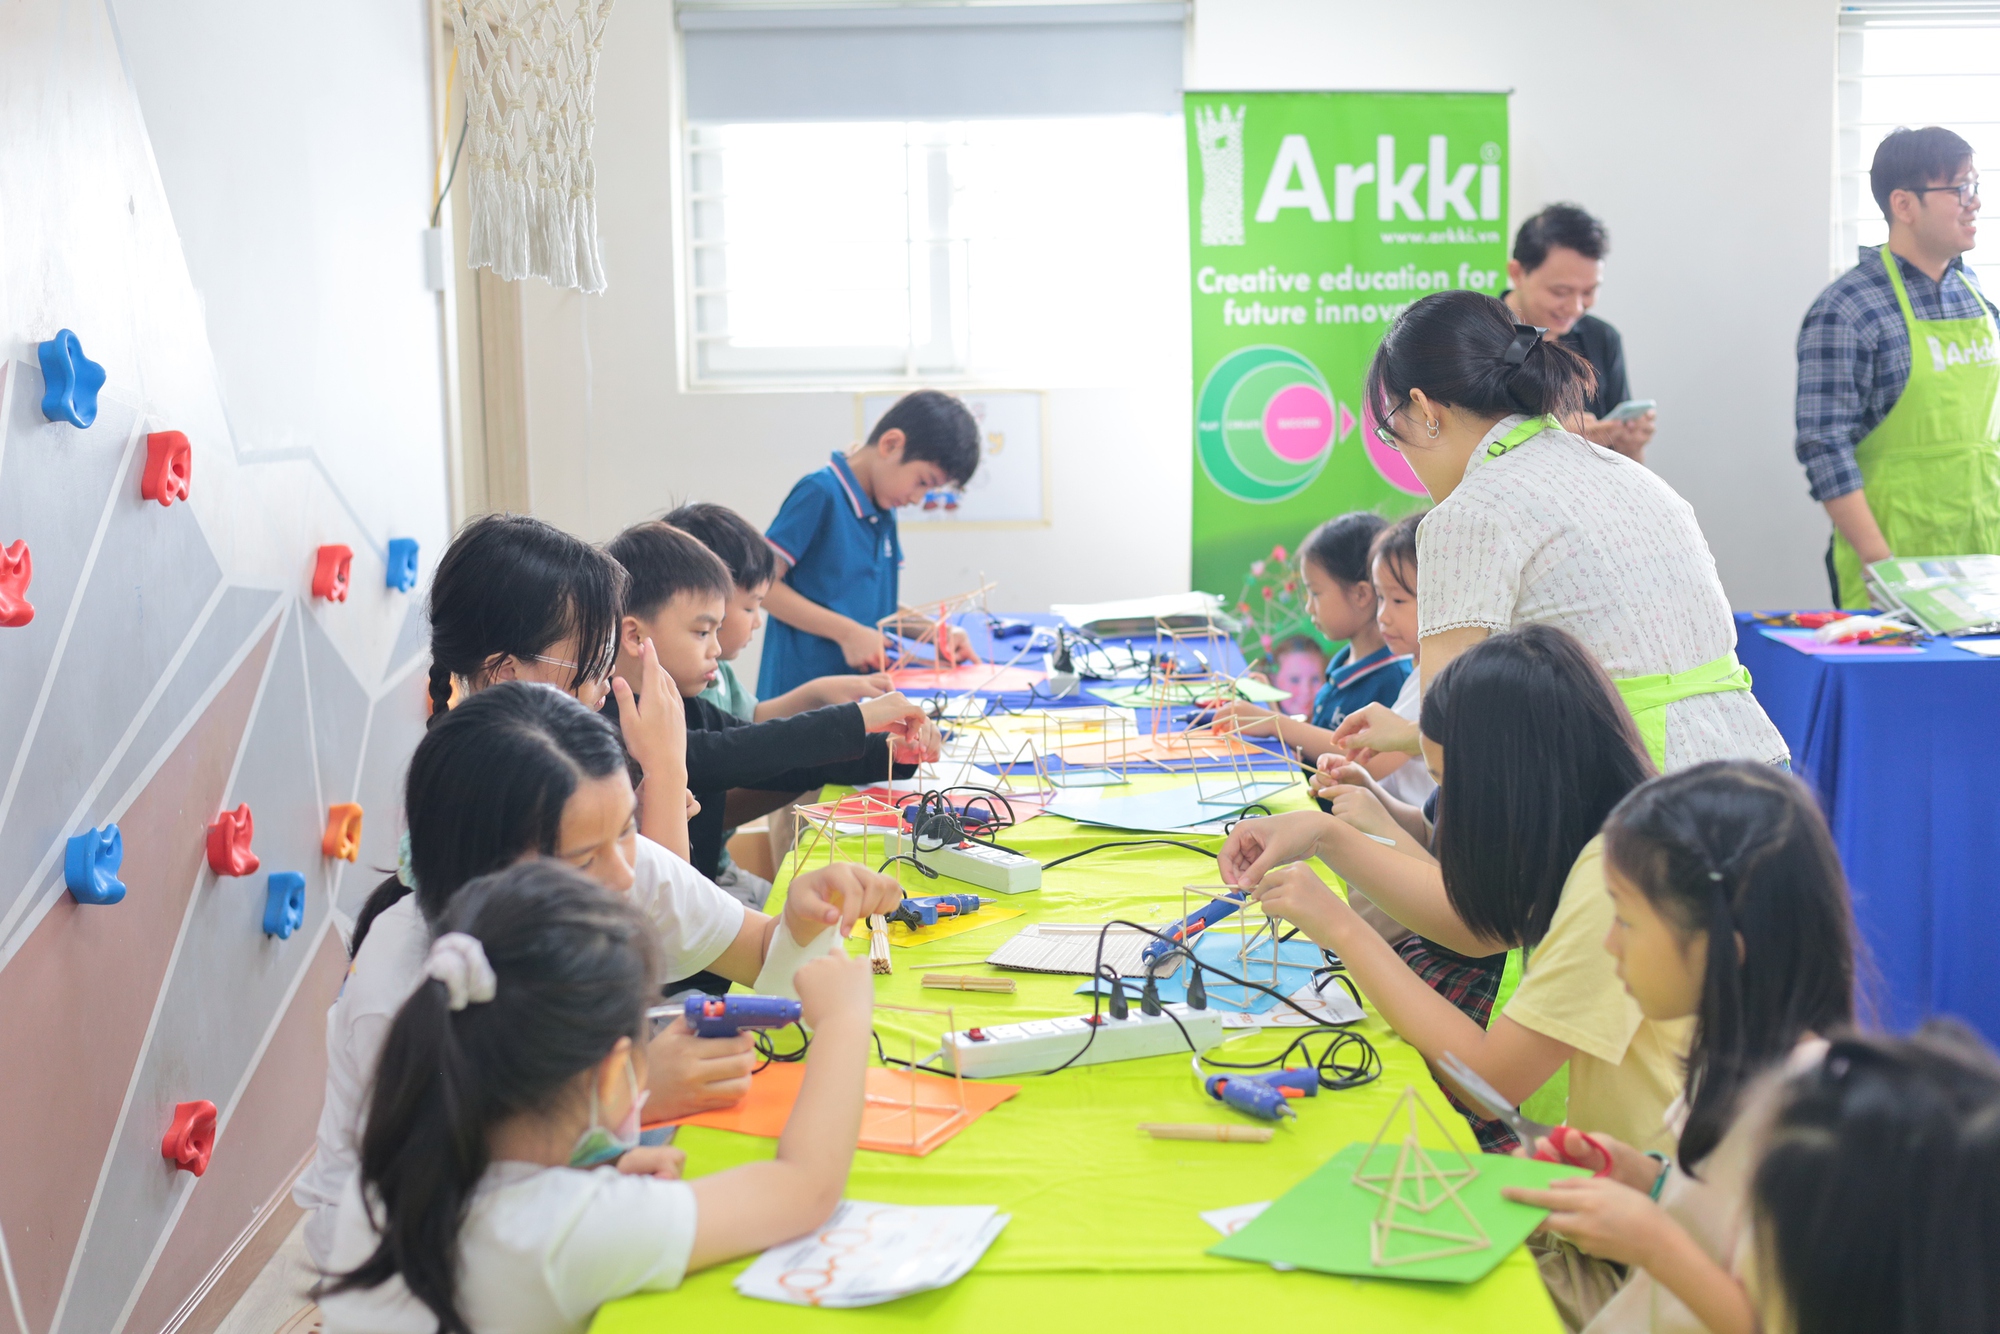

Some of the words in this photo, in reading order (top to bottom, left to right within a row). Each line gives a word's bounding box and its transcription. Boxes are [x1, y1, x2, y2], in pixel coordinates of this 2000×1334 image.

[1255, 134, 1500, 222] Arkki
[1380, 227, 1500, 244] www.arkki.vn
[1197, 265, 1311, 295] Creative
[1318, 263, 1449, 292] education
[1457, 262, 1499, 289] for
[1223, 298, 1307, 326] future
